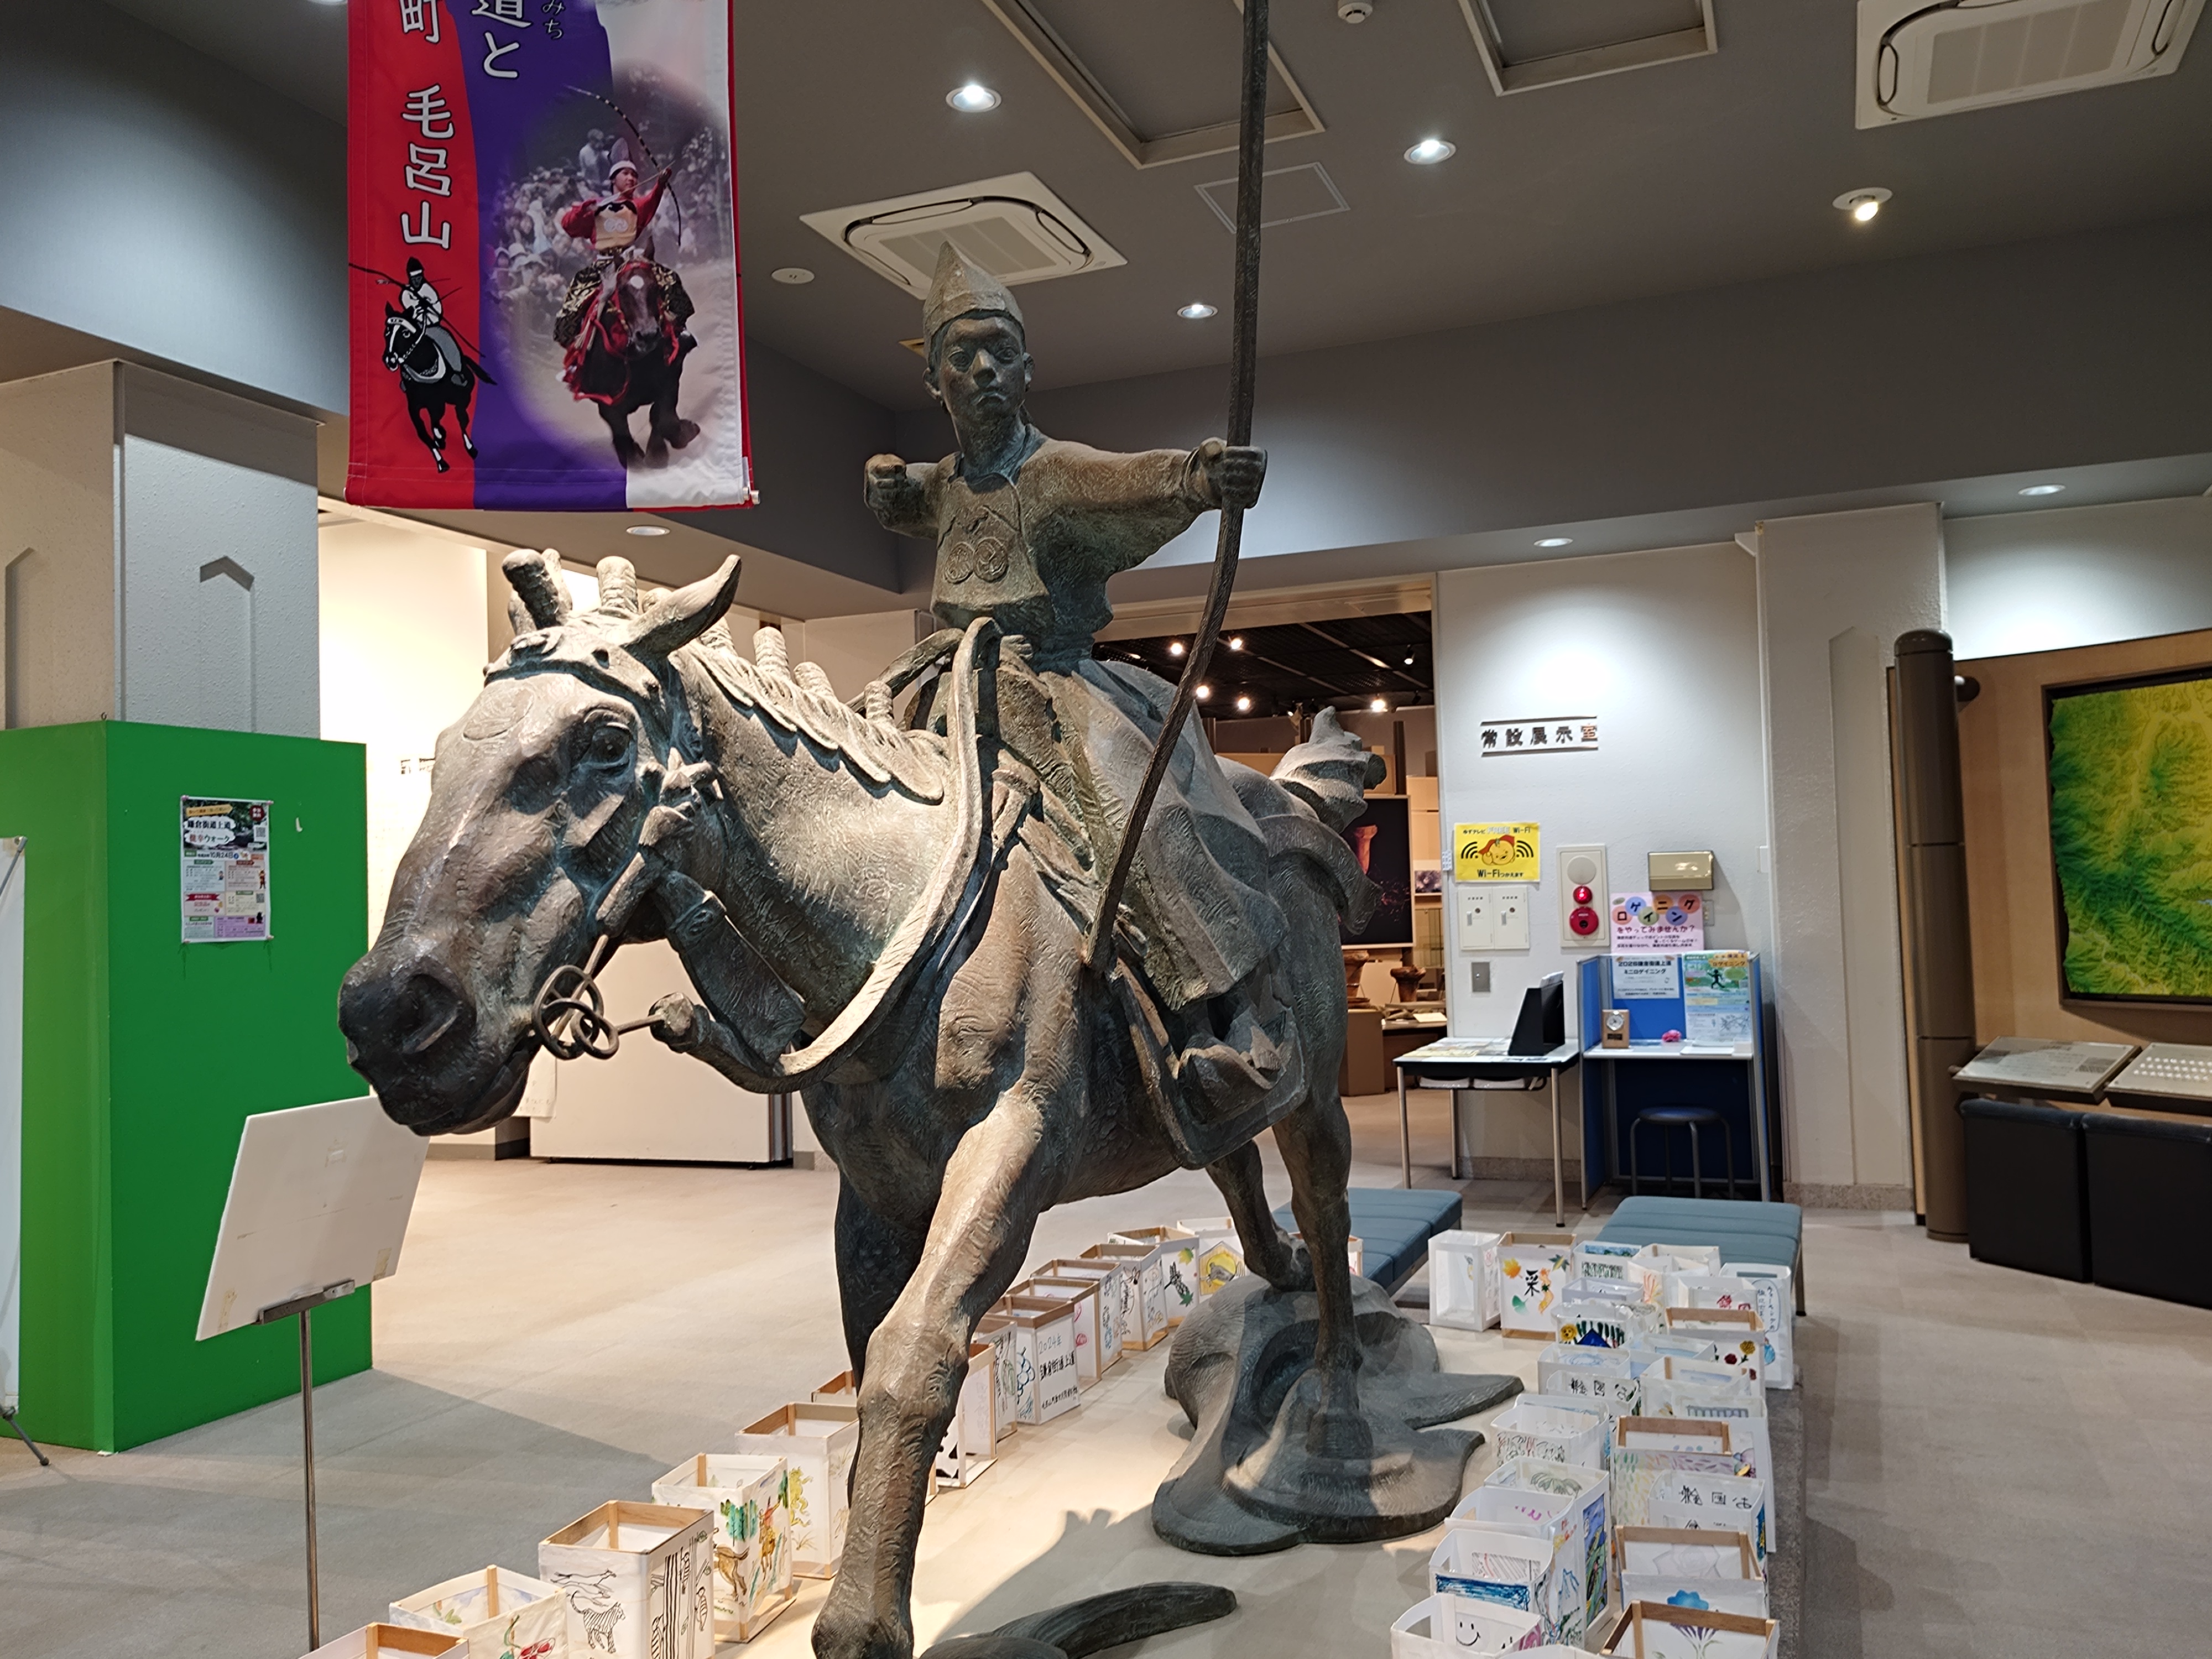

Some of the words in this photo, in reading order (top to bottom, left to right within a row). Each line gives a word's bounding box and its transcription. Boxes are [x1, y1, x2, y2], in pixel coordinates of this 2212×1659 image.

[401, 84, 455, 250] 毛呂山
[1481, 723, 1598, 749] 常設展示室
[187, 820, 231, 830] 鎌倉街道上道
